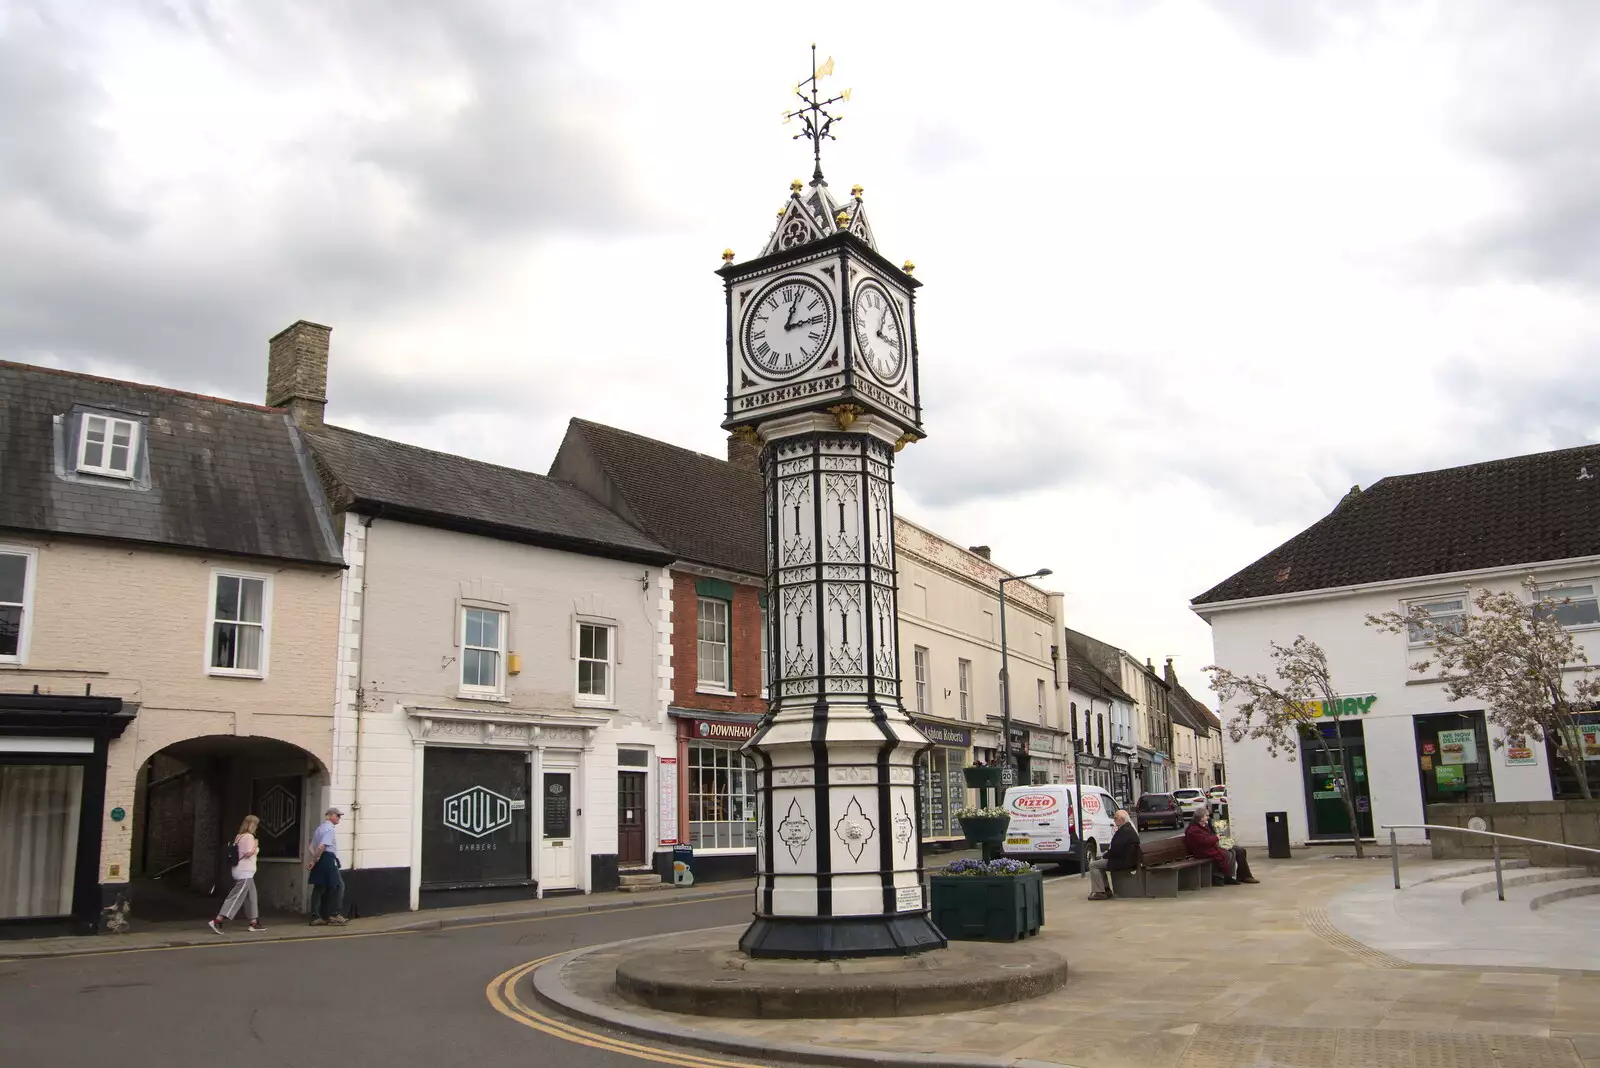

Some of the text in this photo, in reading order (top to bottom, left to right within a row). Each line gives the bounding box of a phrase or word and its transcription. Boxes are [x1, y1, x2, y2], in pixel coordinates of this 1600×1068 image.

[807, 299, 819, 311] II
[710, 724, 752, 738] DOWNHAM
[923, 725, 964, 743] Ashton Roberts
[1018, 798, 1050, 807] Pizza
[448, 791, 507, 833] GOULD
[459, 843, 497, 851] BARBERS
